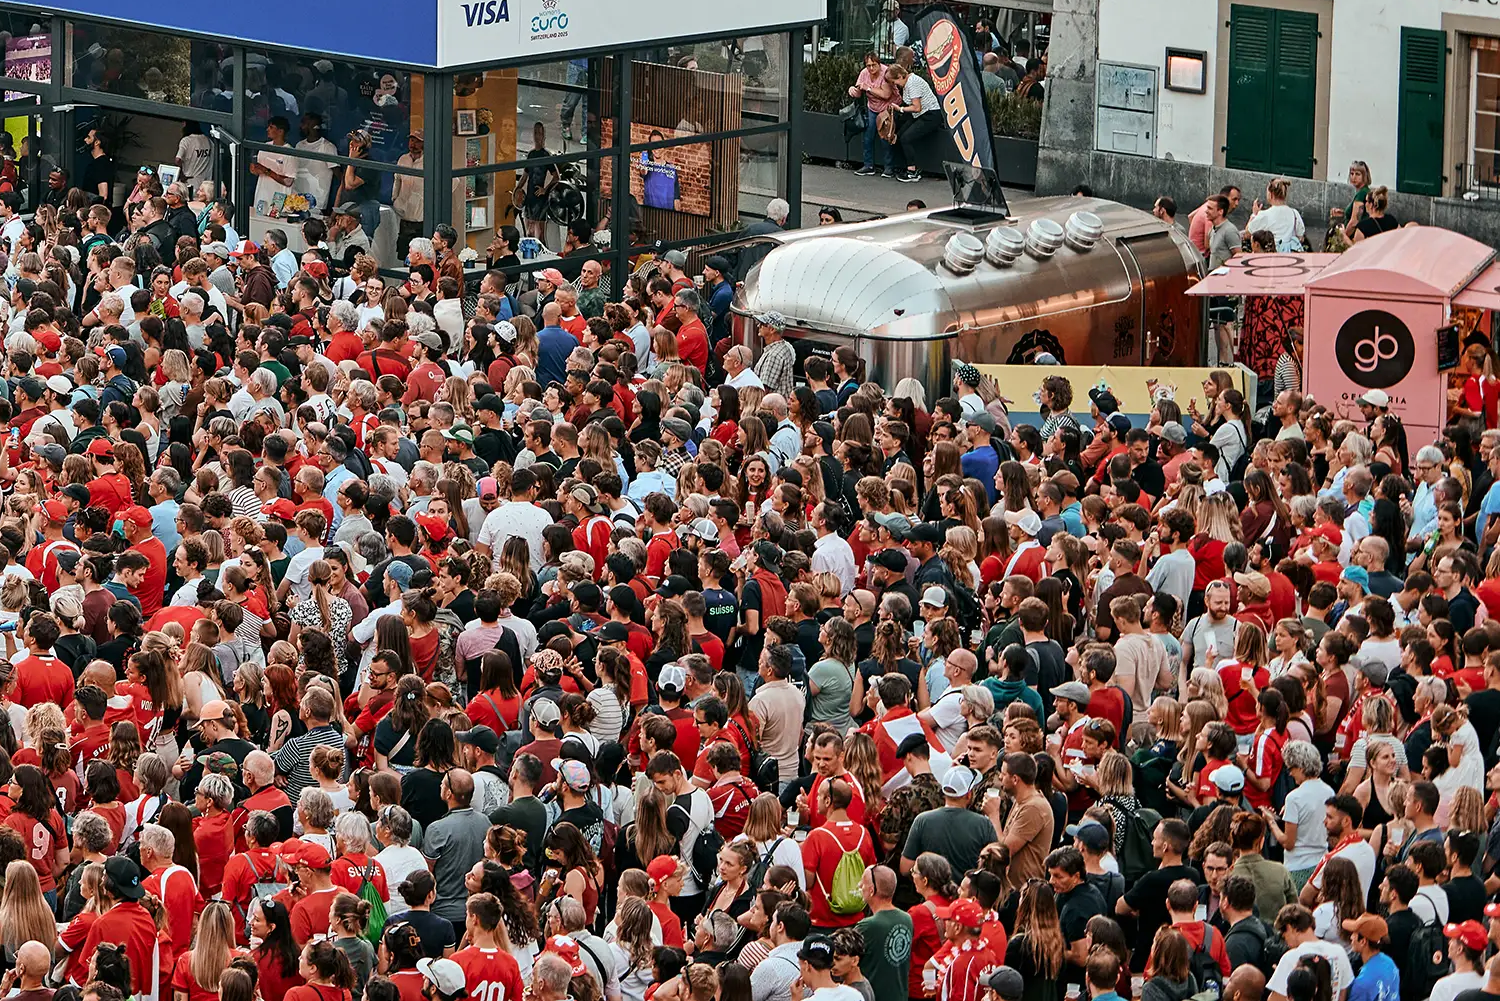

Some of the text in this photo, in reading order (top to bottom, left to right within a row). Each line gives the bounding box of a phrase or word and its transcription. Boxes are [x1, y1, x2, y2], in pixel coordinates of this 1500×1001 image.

[460, 0, 510, 27] VISA
[811, 347, 830, 356] American
[1354, 325, 1398, 372] gb
[32, 822, 50, 859] 9
[471, 980, 505, 1001] 10
